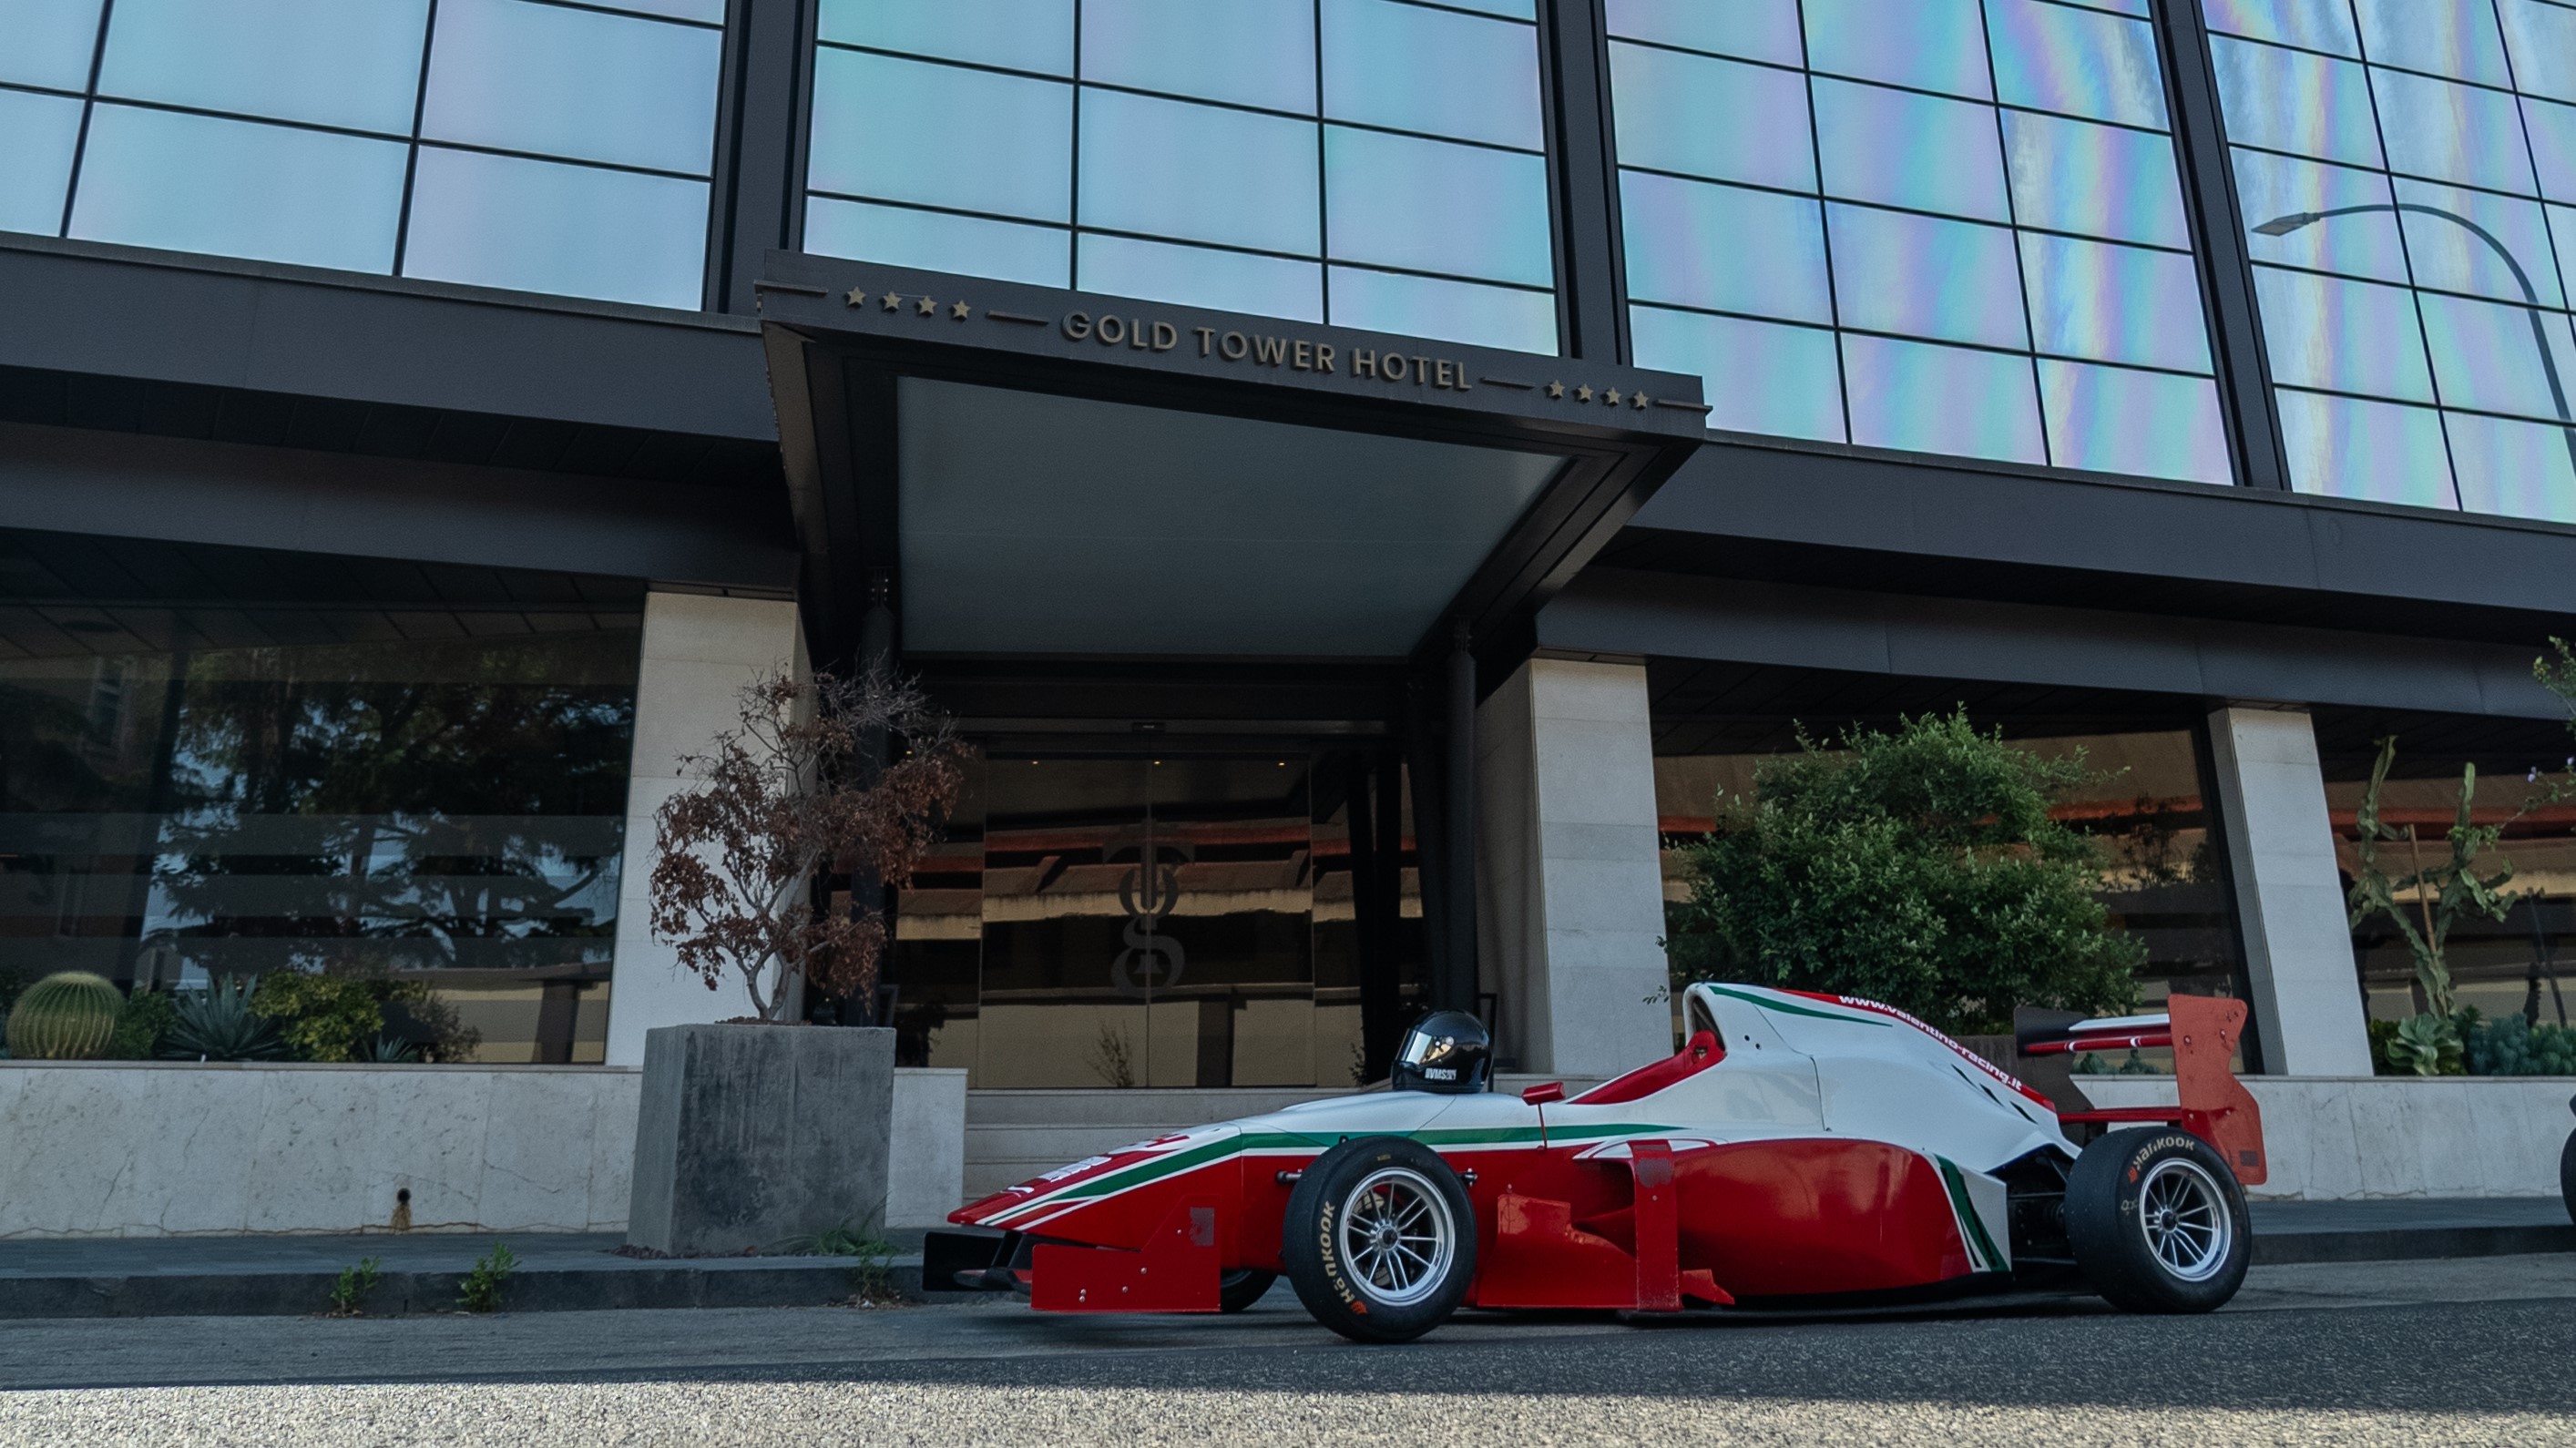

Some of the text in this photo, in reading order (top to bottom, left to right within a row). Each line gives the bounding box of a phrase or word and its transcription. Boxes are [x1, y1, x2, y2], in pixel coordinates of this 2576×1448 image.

[1061, 310, 1473, 391] GOLD TOWER HOTEL
[1838, 994, 2023, 1092] www.valentino-racing.it
